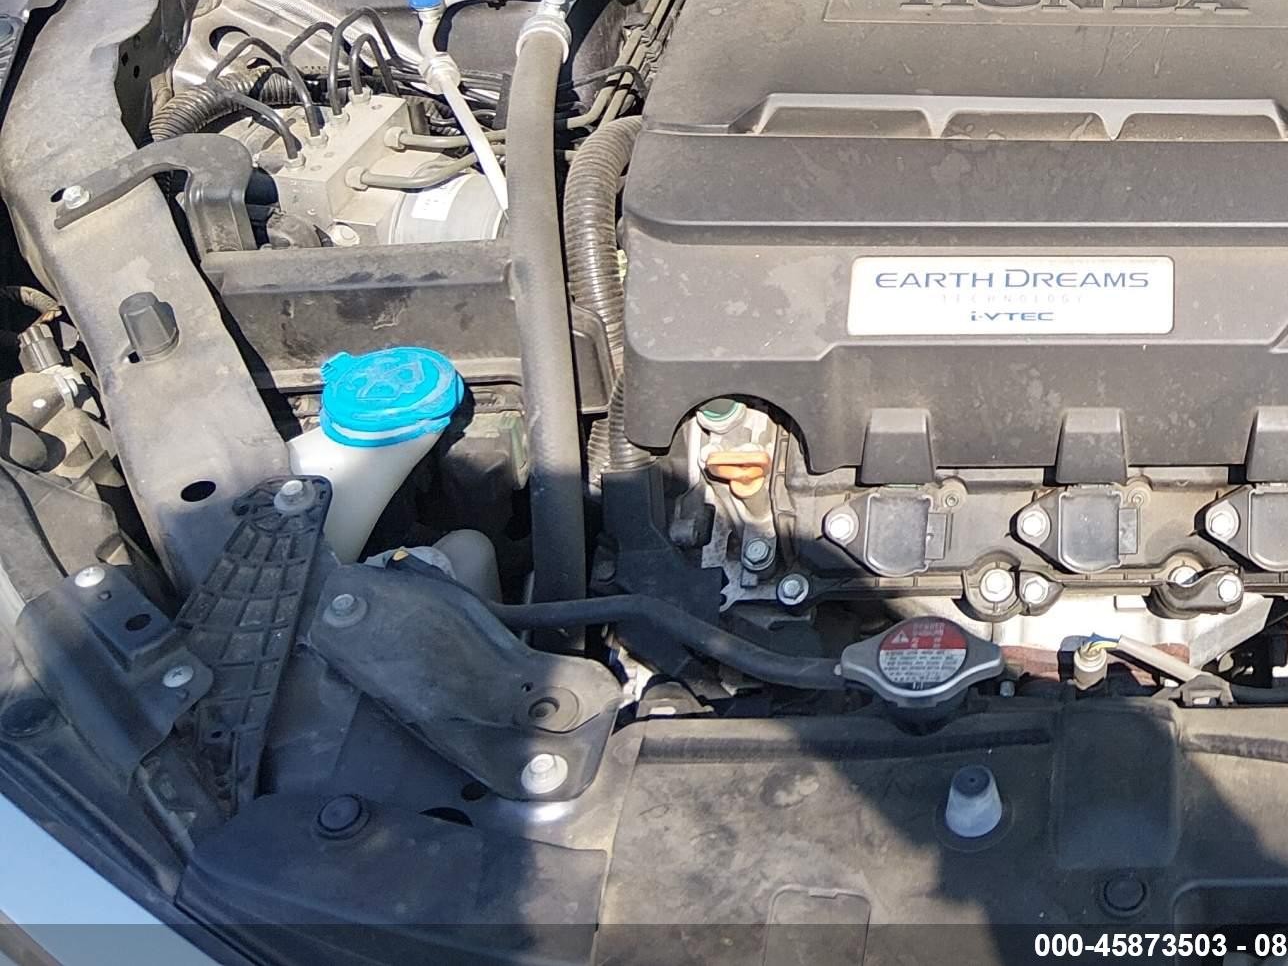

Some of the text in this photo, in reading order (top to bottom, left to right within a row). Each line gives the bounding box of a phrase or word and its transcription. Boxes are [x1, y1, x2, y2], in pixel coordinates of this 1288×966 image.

[874, 269, 1150, 289] EARTH DREAMS
[970, 310, 1055, 322] i-VTEC
